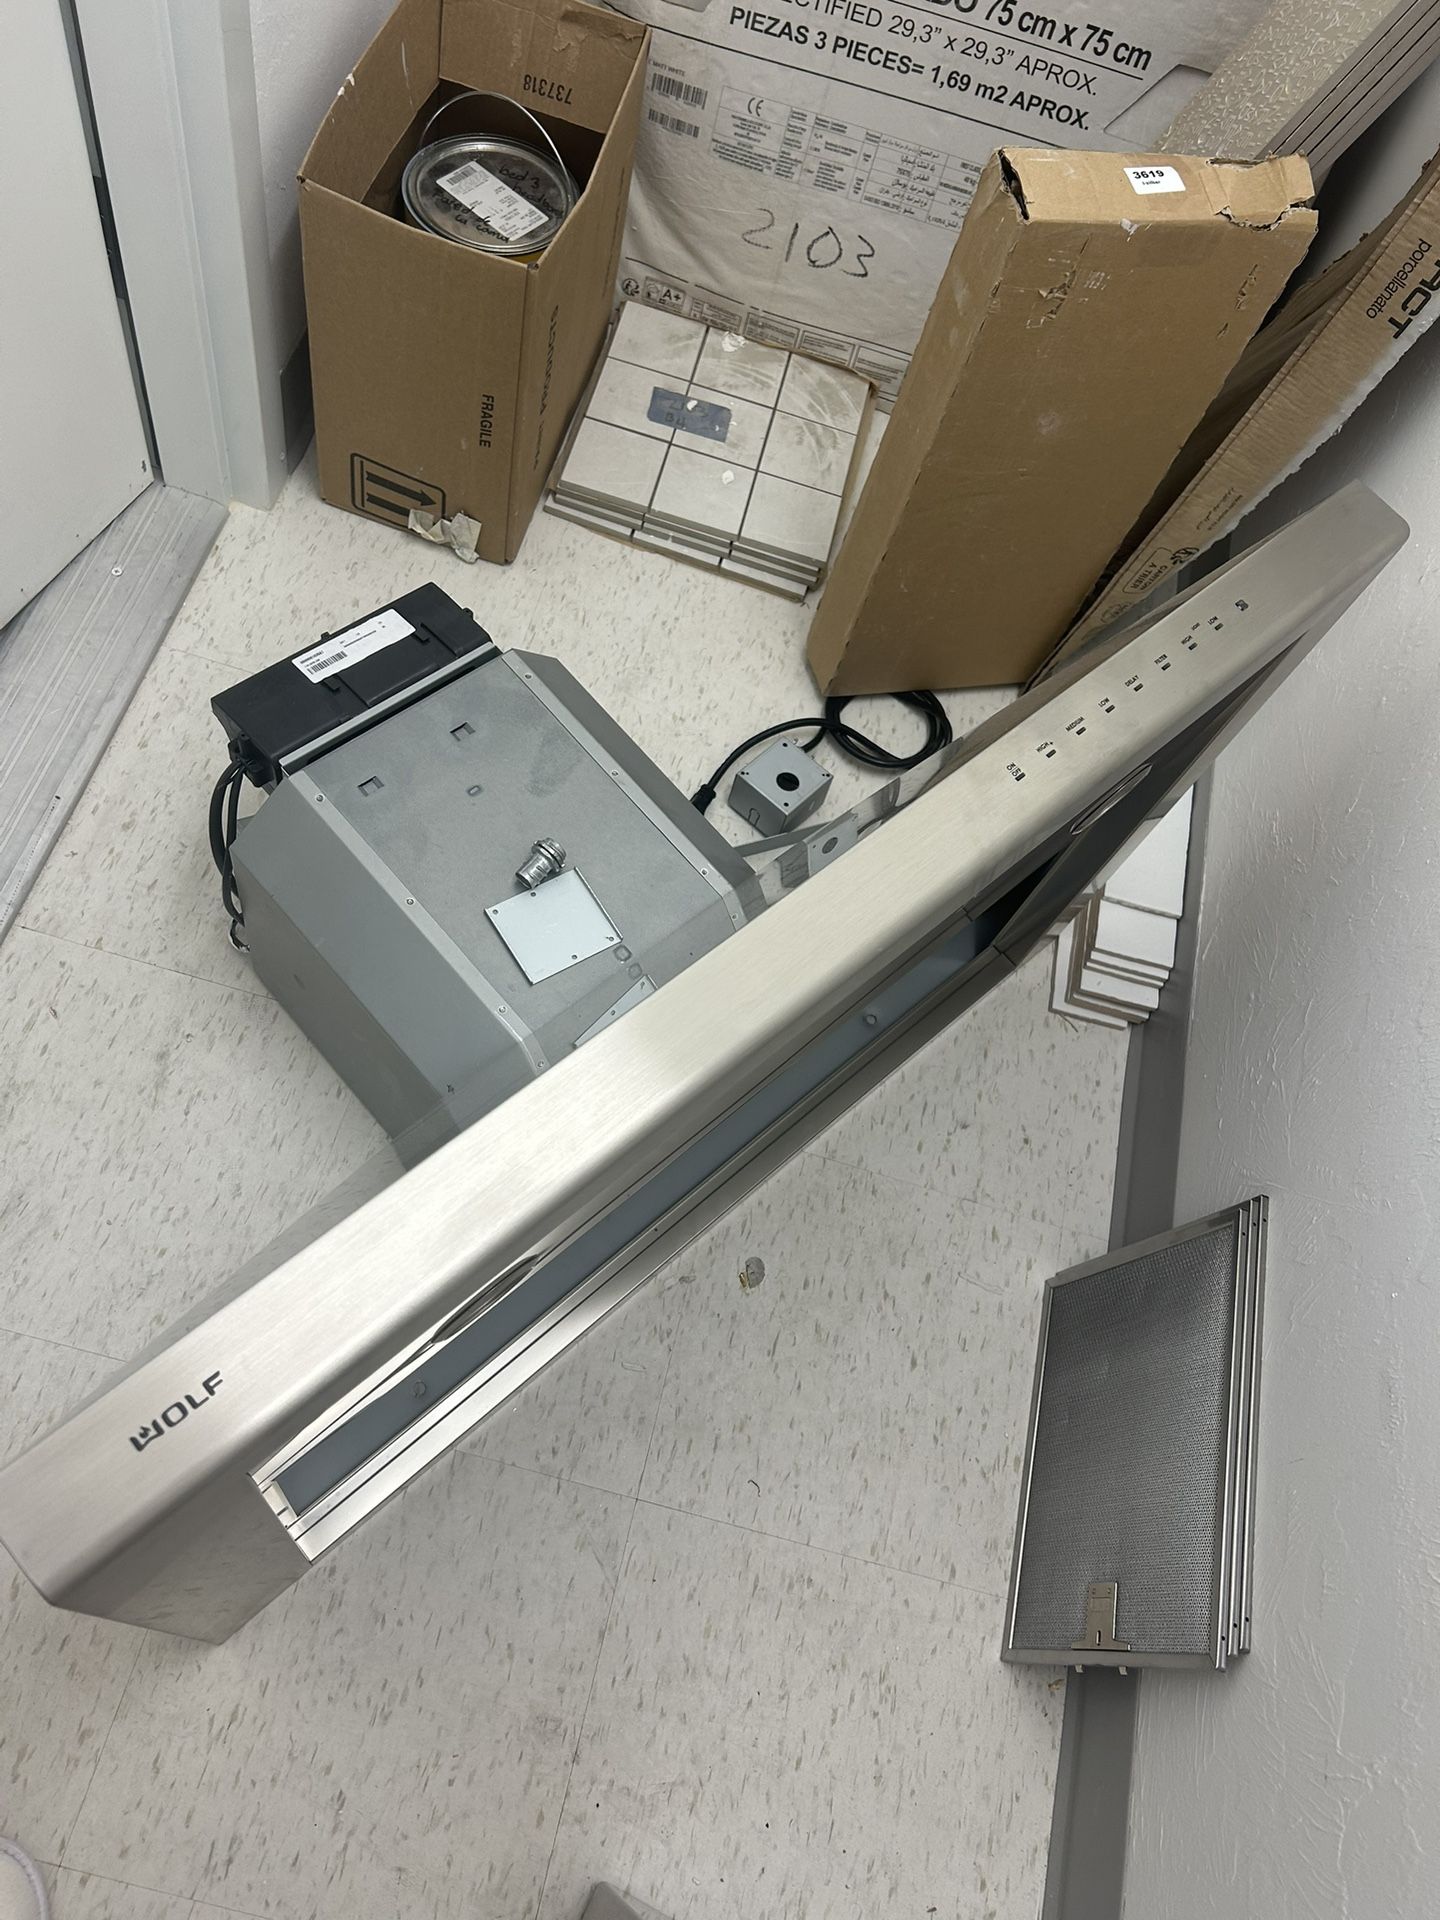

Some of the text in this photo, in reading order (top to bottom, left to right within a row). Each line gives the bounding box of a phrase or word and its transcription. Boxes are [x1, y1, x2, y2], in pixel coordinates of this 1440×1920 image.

[729, 6, 810, 46] PIEZAS
[814, 31, 828, 51] 3
[930, 65, 972, 92] 1,69
[974, 82, 1010, 104] m2
[1008, 90, 1091, 131] APROX.
[943, 35, 957, 52] x
[1015, 55, 1098, 97] APROX.
[1017, 12, 1057, 42] cm
[1058, 24, 1076, 47] x
[1081, 24, 1115, 57] 75
[1112, 42, 1153, 71] cm
[523, 73, 573, 106] 737318
[1132, 170, 1164, 179] 3619
[741, 208, 876, 278] 2103
[1366, 238, 1433, 320] porcellanato
[478, 393, 495, 449] FRAGILE
[1124, 674, 1139, 687] DELAY
[1065, 716, 1085, 731] MEDIUM
[129, 1370, 224, 1452] WOLF
